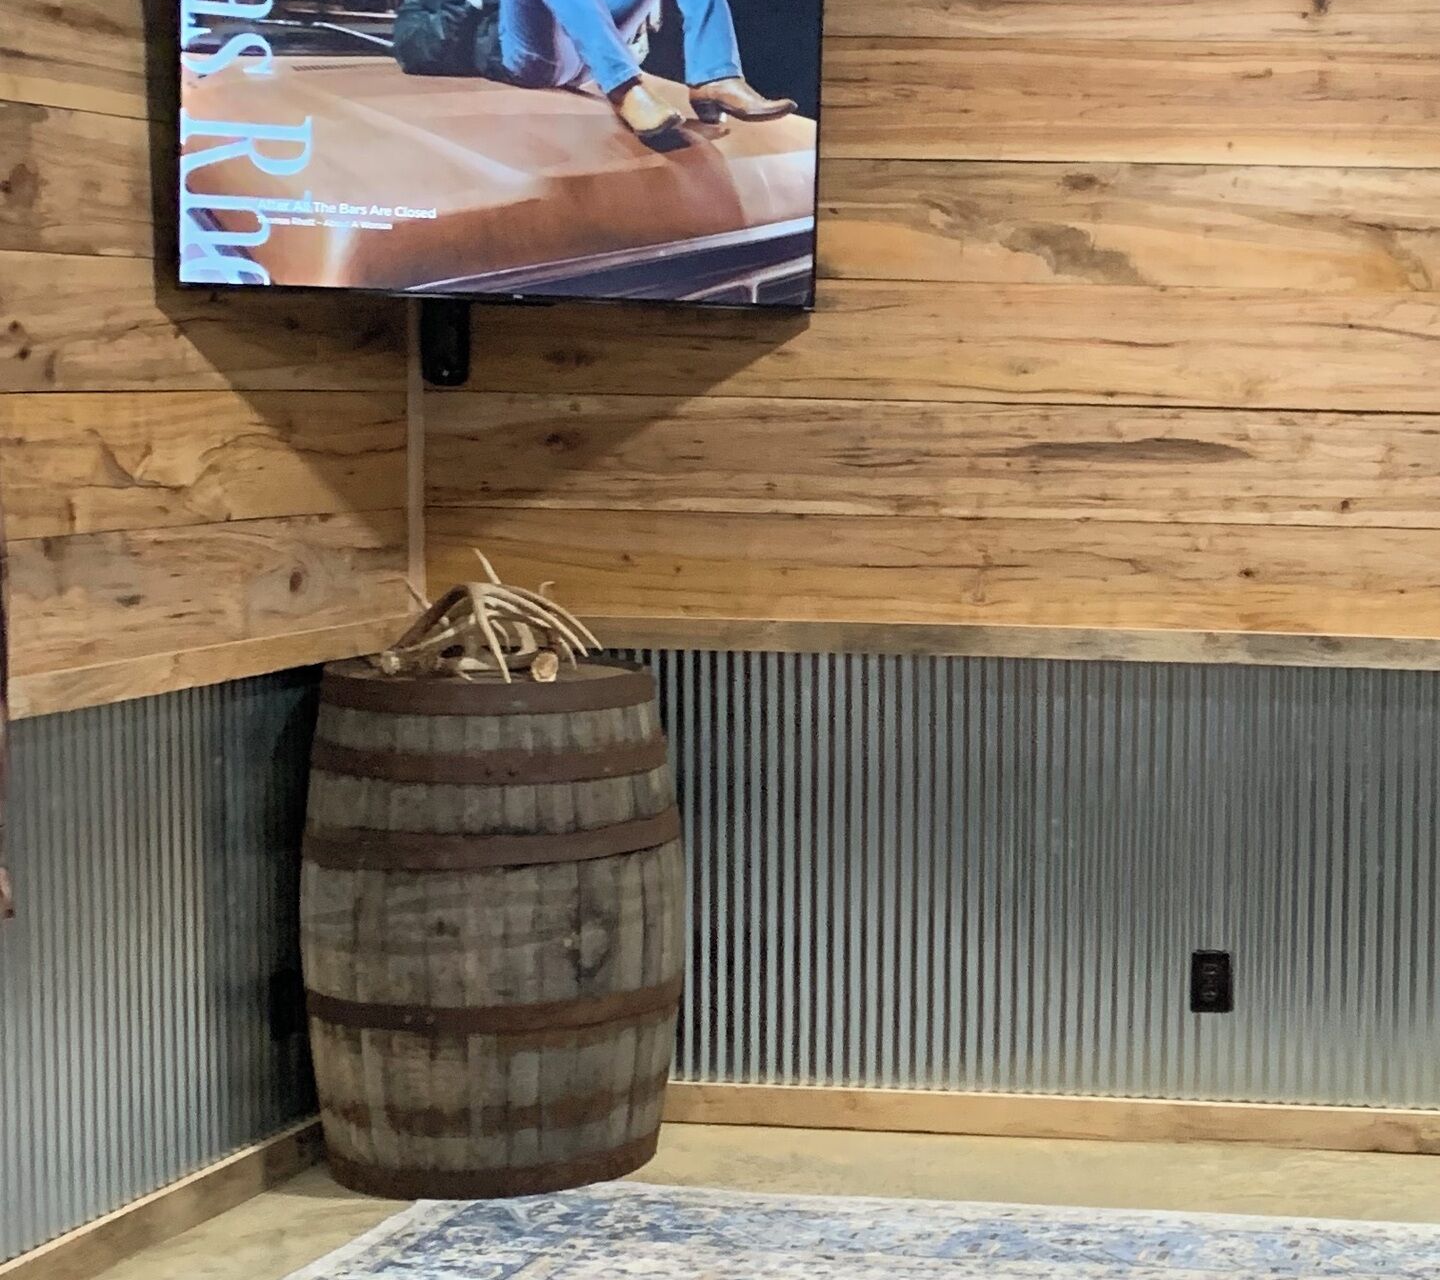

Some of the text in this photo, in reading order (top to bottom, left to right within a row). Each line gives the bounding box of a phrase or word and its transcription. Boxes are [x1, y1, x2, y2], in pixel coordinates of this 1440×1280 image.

[313, 201, 337, 215] The
[339, 203, 367, 216] Bars
[369, 204, 393, 218] Are
[394, 206, 437, 219] Closed
